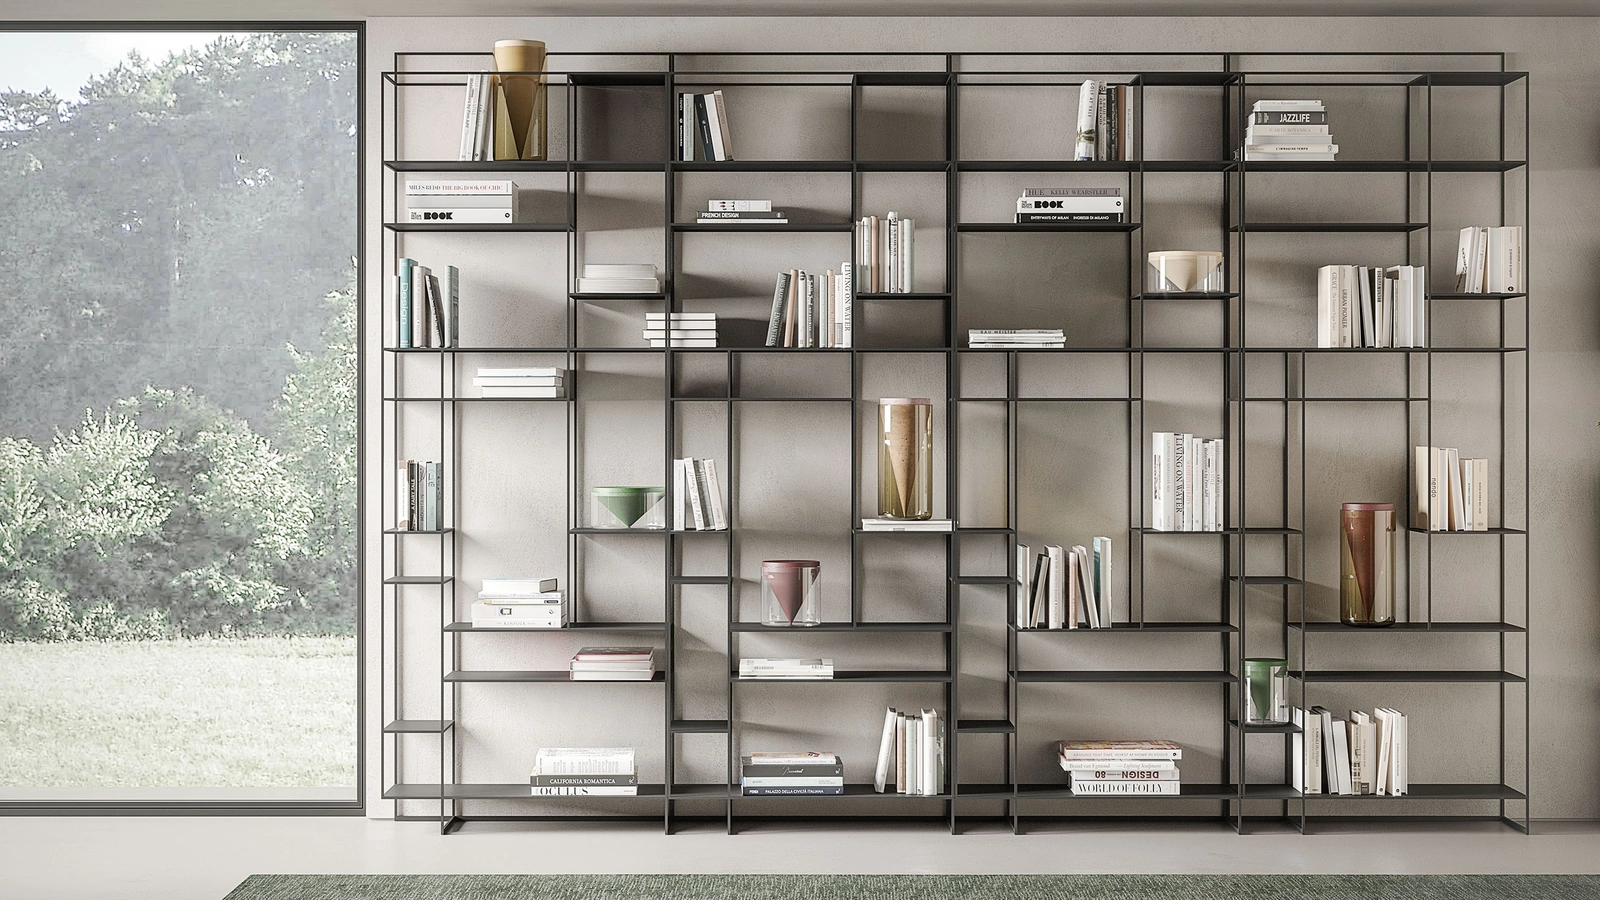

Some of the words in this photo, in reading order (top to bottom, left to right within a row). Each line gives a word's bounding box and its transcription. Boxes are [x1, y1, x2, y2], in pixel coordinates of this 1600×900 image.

[1280, 113, 1310, 122] JAZZLIFE
[845, 293, 850, 304] ON
[1176, 470, 1182, 482] ON
[553, 760, 566, 774] arts
[578, 759, 618, 774] architecture
[540, 787, 588, 795] OCULUS
[1079, 784, 1115, 792] WORLD
[1117, 784, 1130, 792] OF
[1132, 784, 1162, 792] FOLLY
